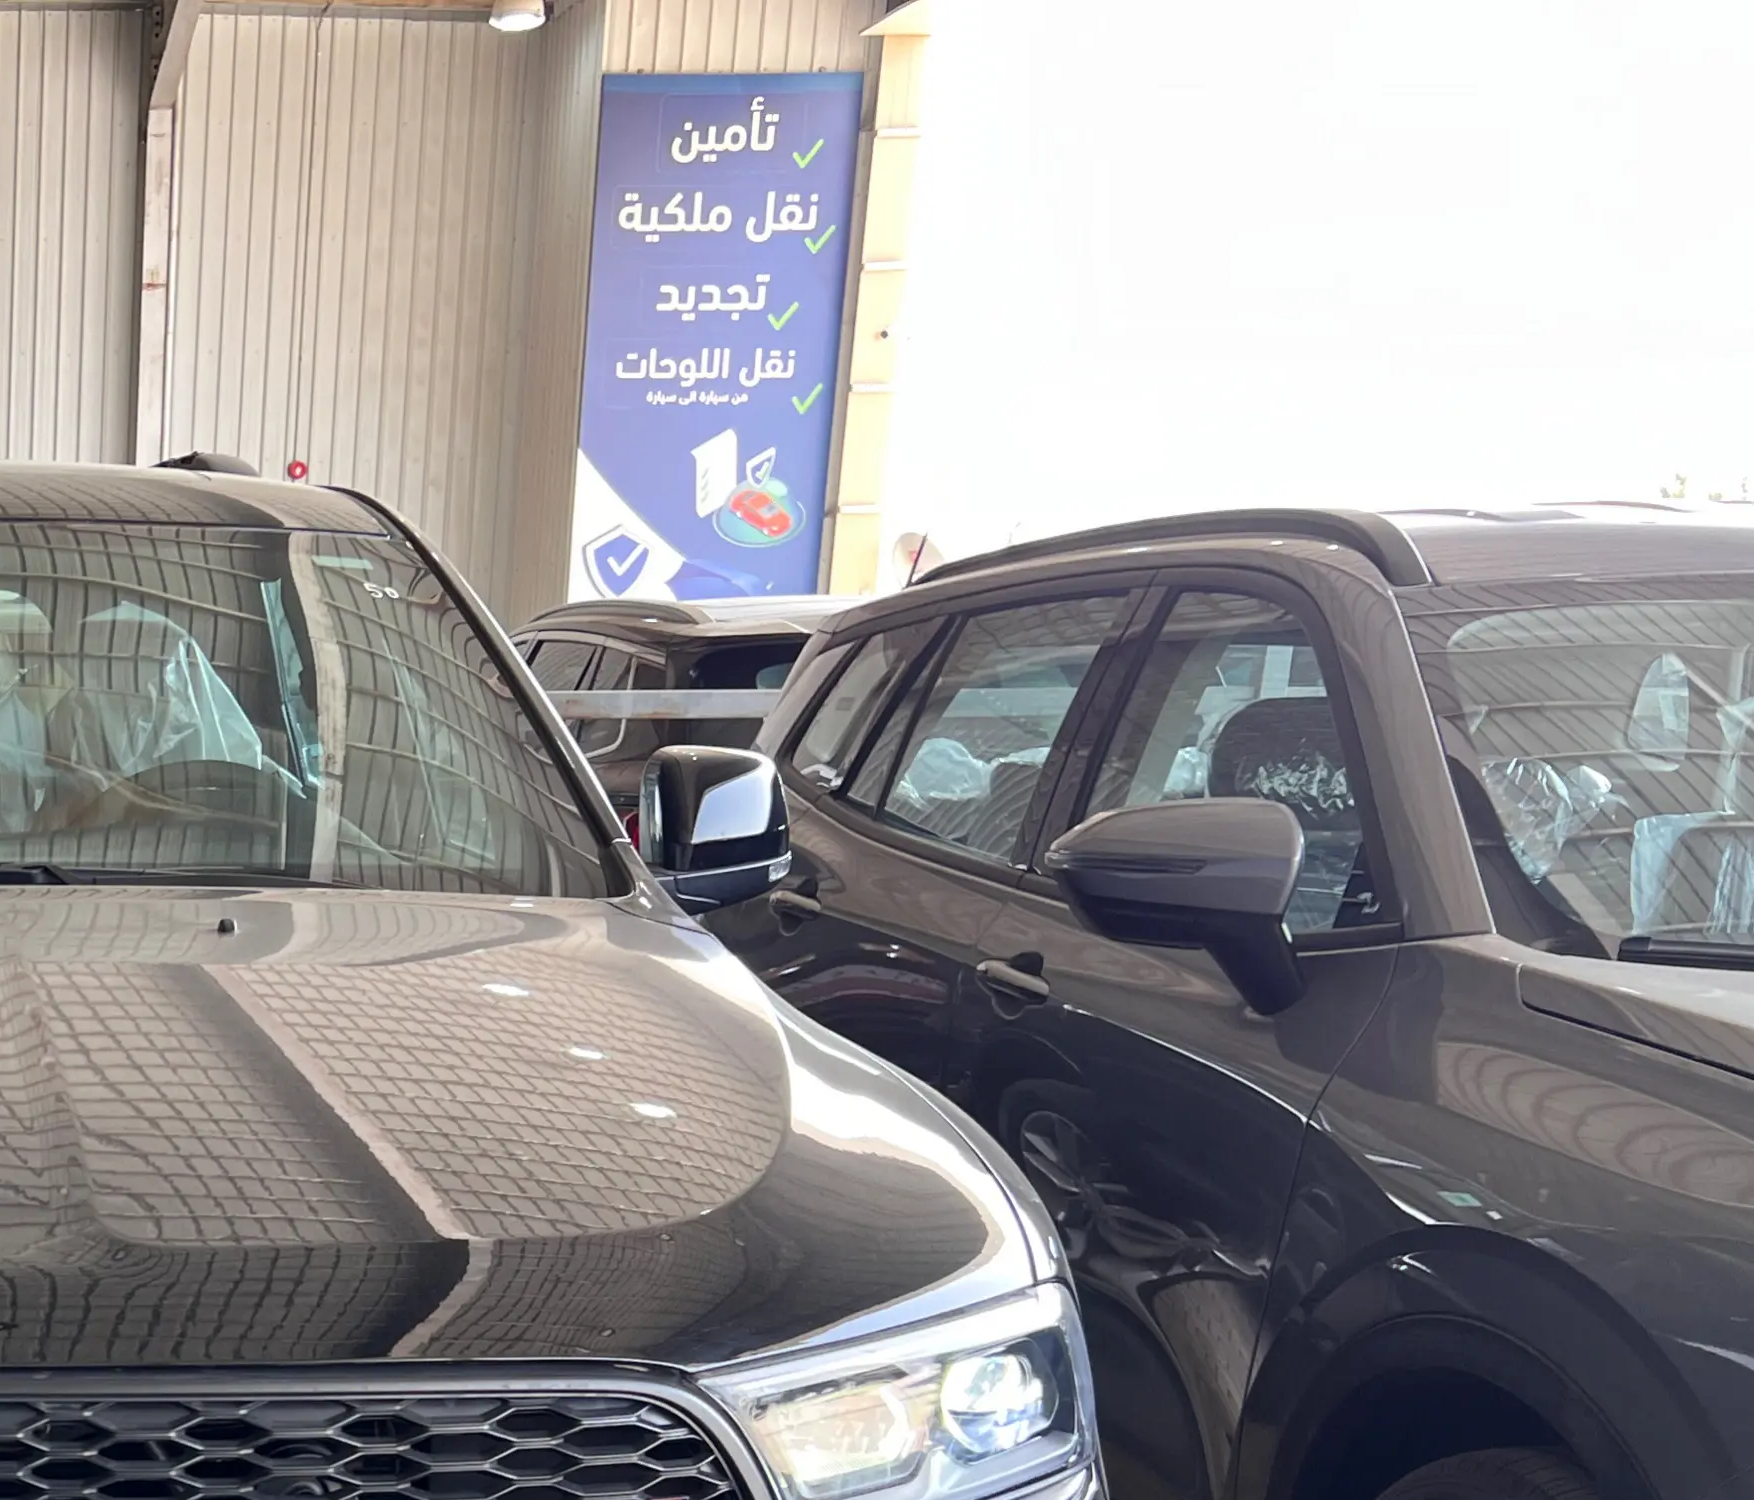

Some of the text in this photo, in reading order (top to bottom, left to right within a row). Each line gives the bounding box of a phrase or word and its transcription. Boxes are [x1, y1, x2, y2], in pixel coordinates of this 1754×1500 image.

[670, 96, 779, 163] تأمين
[617, 190, 819, 243] نقل ملكية
[655, 274, 770, 321] تجديد
[615, 347, 796, 387] نقل اللوحات
[646, 390, 677, 405] سيارة
[698, 390, 729, 405] سيارة
[730, 392, 749, 405] من
